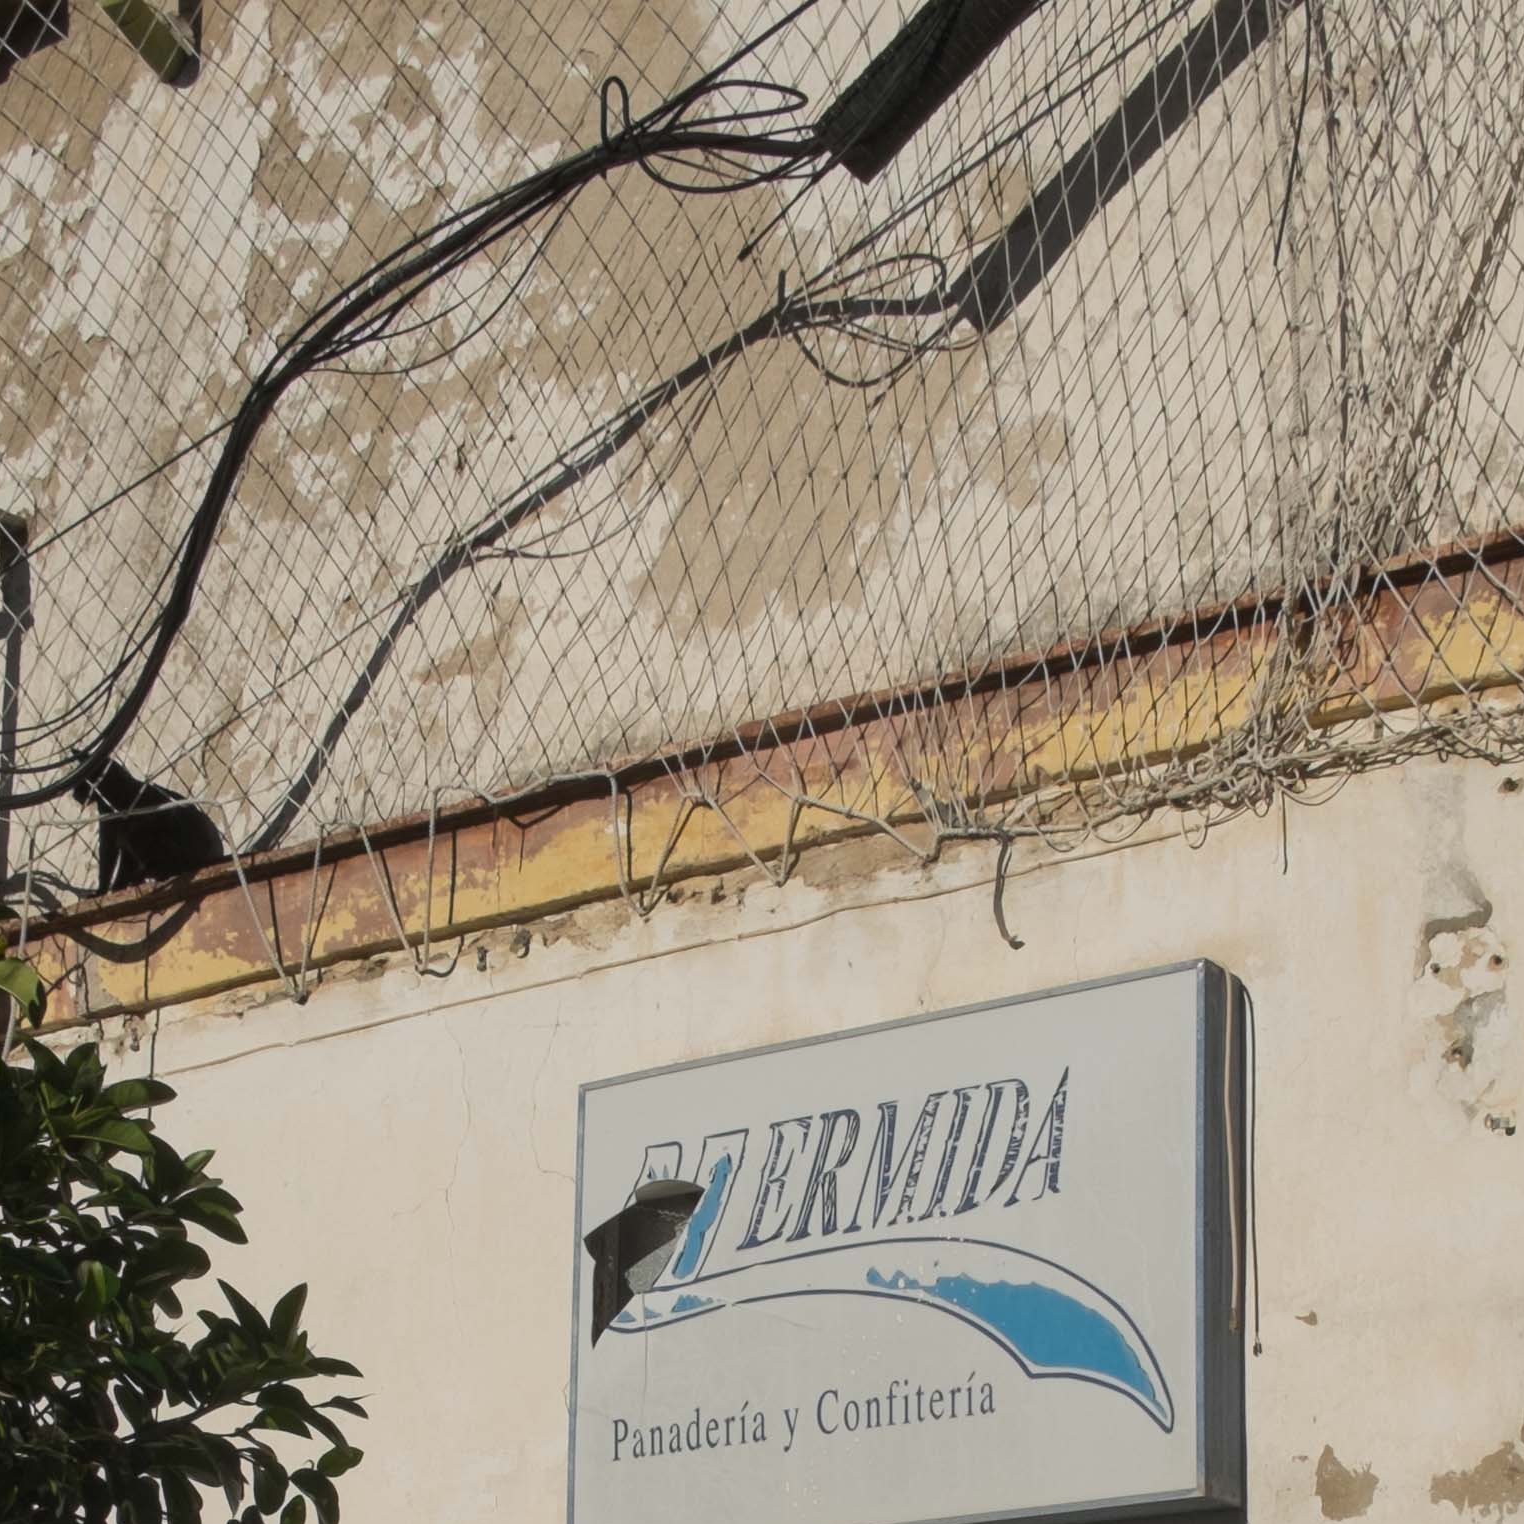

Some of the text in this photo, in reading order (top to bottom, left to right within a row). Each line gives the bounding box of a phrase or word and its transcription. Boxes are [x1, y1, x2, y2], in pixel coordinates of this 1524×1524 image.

[612, 1370, 996, 1462] Panadería y Confitería
